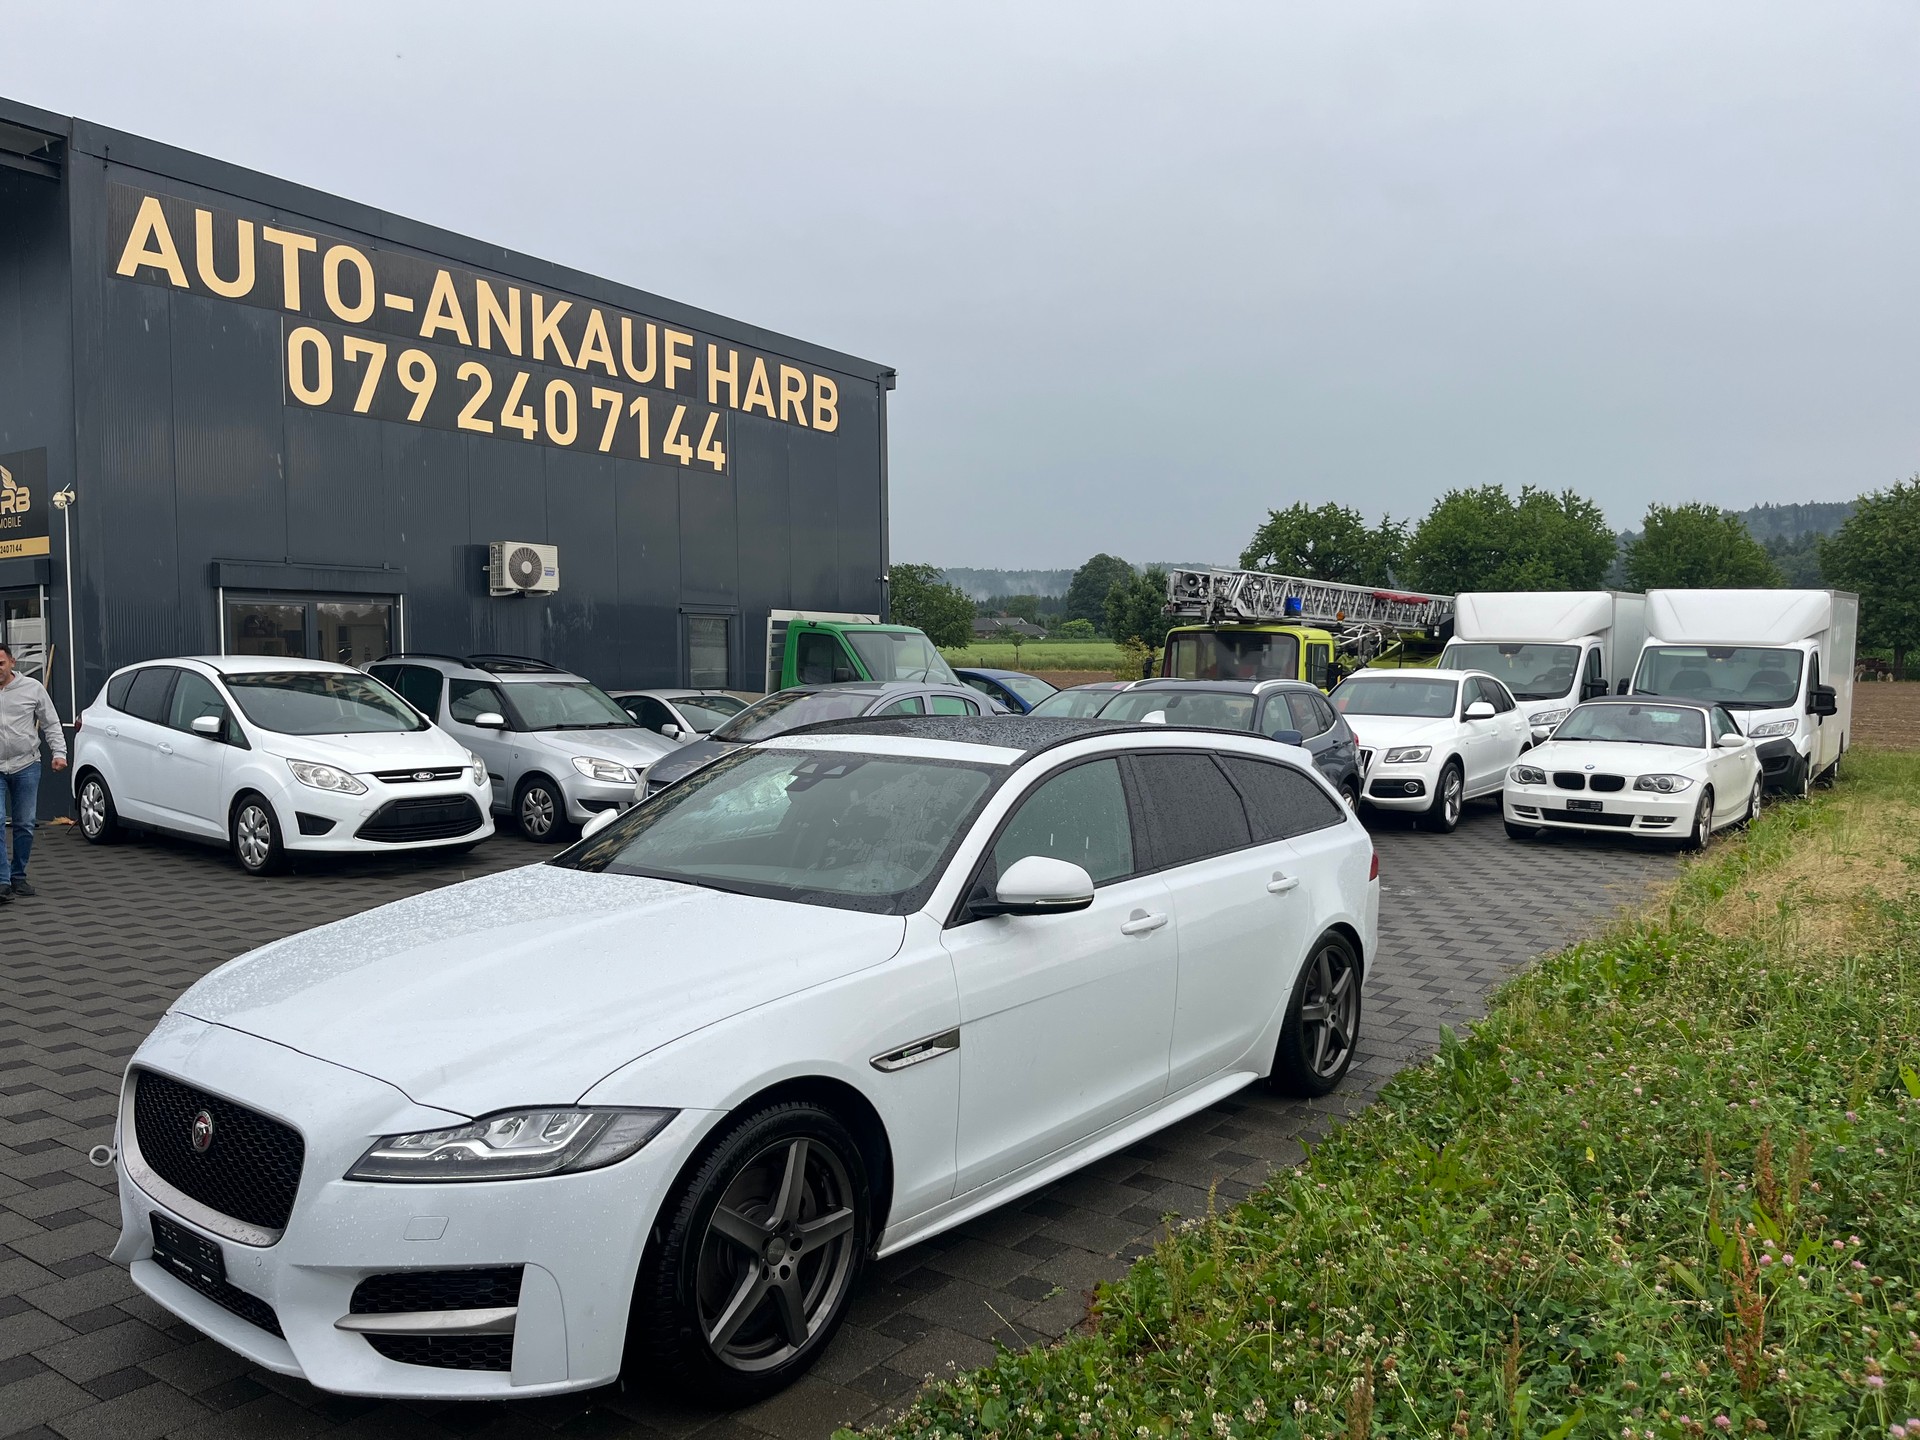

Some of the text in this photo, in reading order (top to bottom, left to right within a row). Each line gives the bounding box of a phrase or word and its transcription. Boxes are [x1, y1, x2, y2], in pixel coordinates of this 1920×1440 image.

[116, 196, 840, 433] AUTO-ANKAUF HARB
[287, 325, 727, 472] 079 240 71 44
[0, 486, 31, 515] RB
